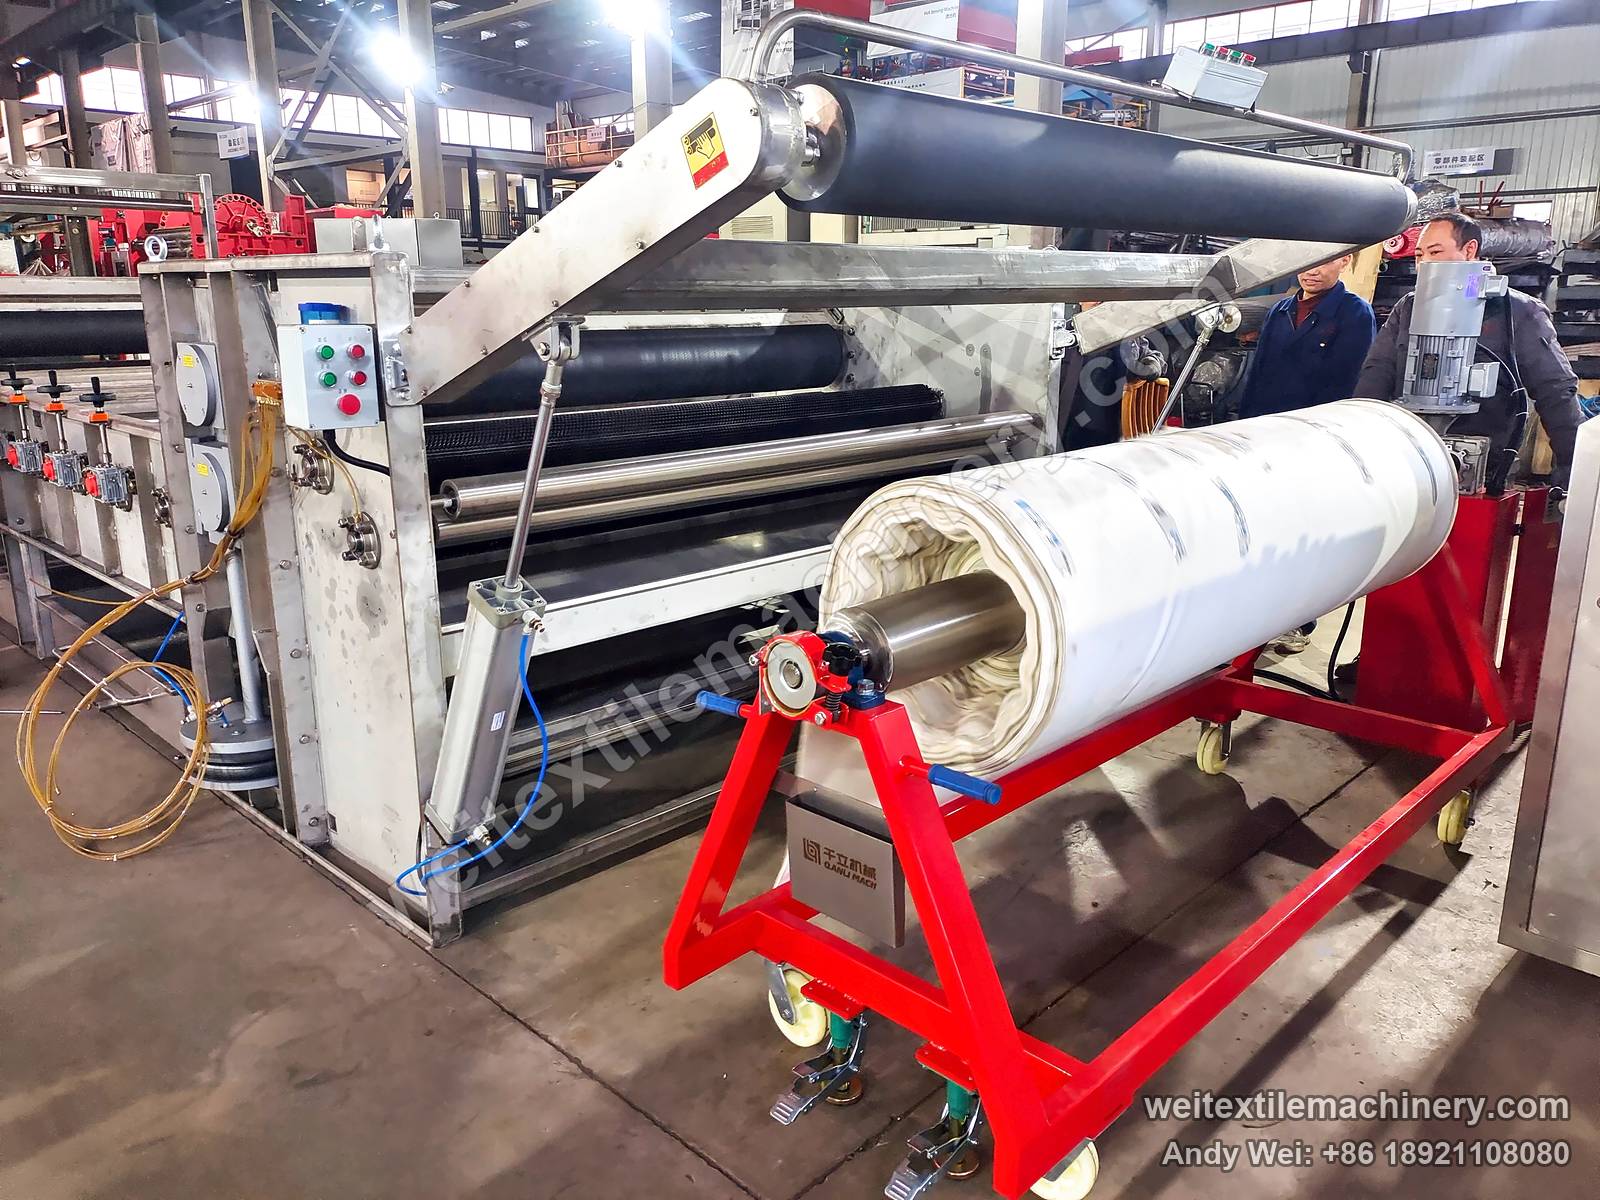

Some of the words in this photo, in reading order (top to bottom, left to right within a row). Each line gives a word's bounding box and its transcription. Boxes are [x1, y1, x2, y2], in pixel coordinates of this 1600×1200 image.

[823, 846, 877, 881] 千立机械
[852, 873, 877, 890] MACH
